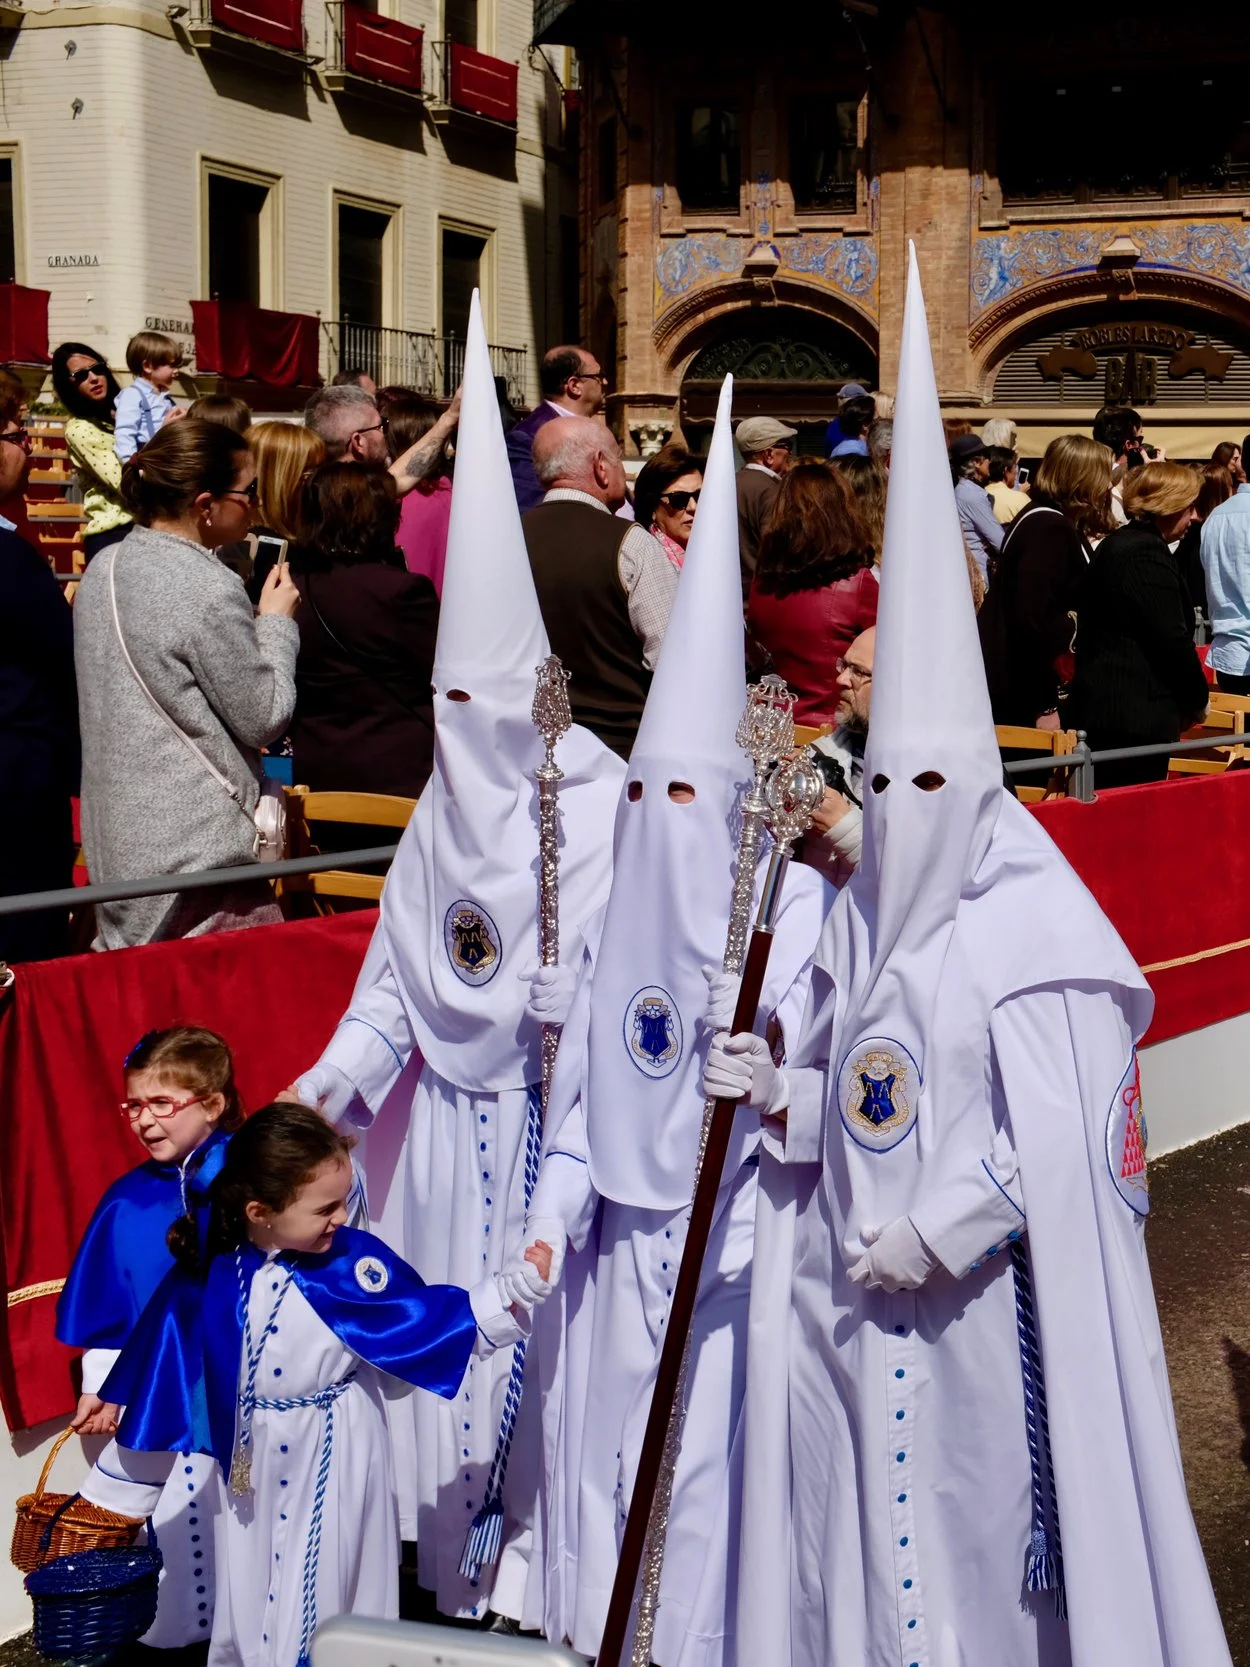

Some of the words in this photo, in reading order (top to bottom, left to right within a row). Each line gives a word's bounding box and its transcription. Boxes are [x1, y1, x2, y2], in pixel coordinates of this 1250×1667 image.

[47, 255, 100, 267] GRANADA
[145, 316, 194, 335] GENERA
[1081, 326, 1131, 350] ROBLES
[1131, 325, 1186, 350] LAREDO
[1105, 350, 1158, 402] BAR
